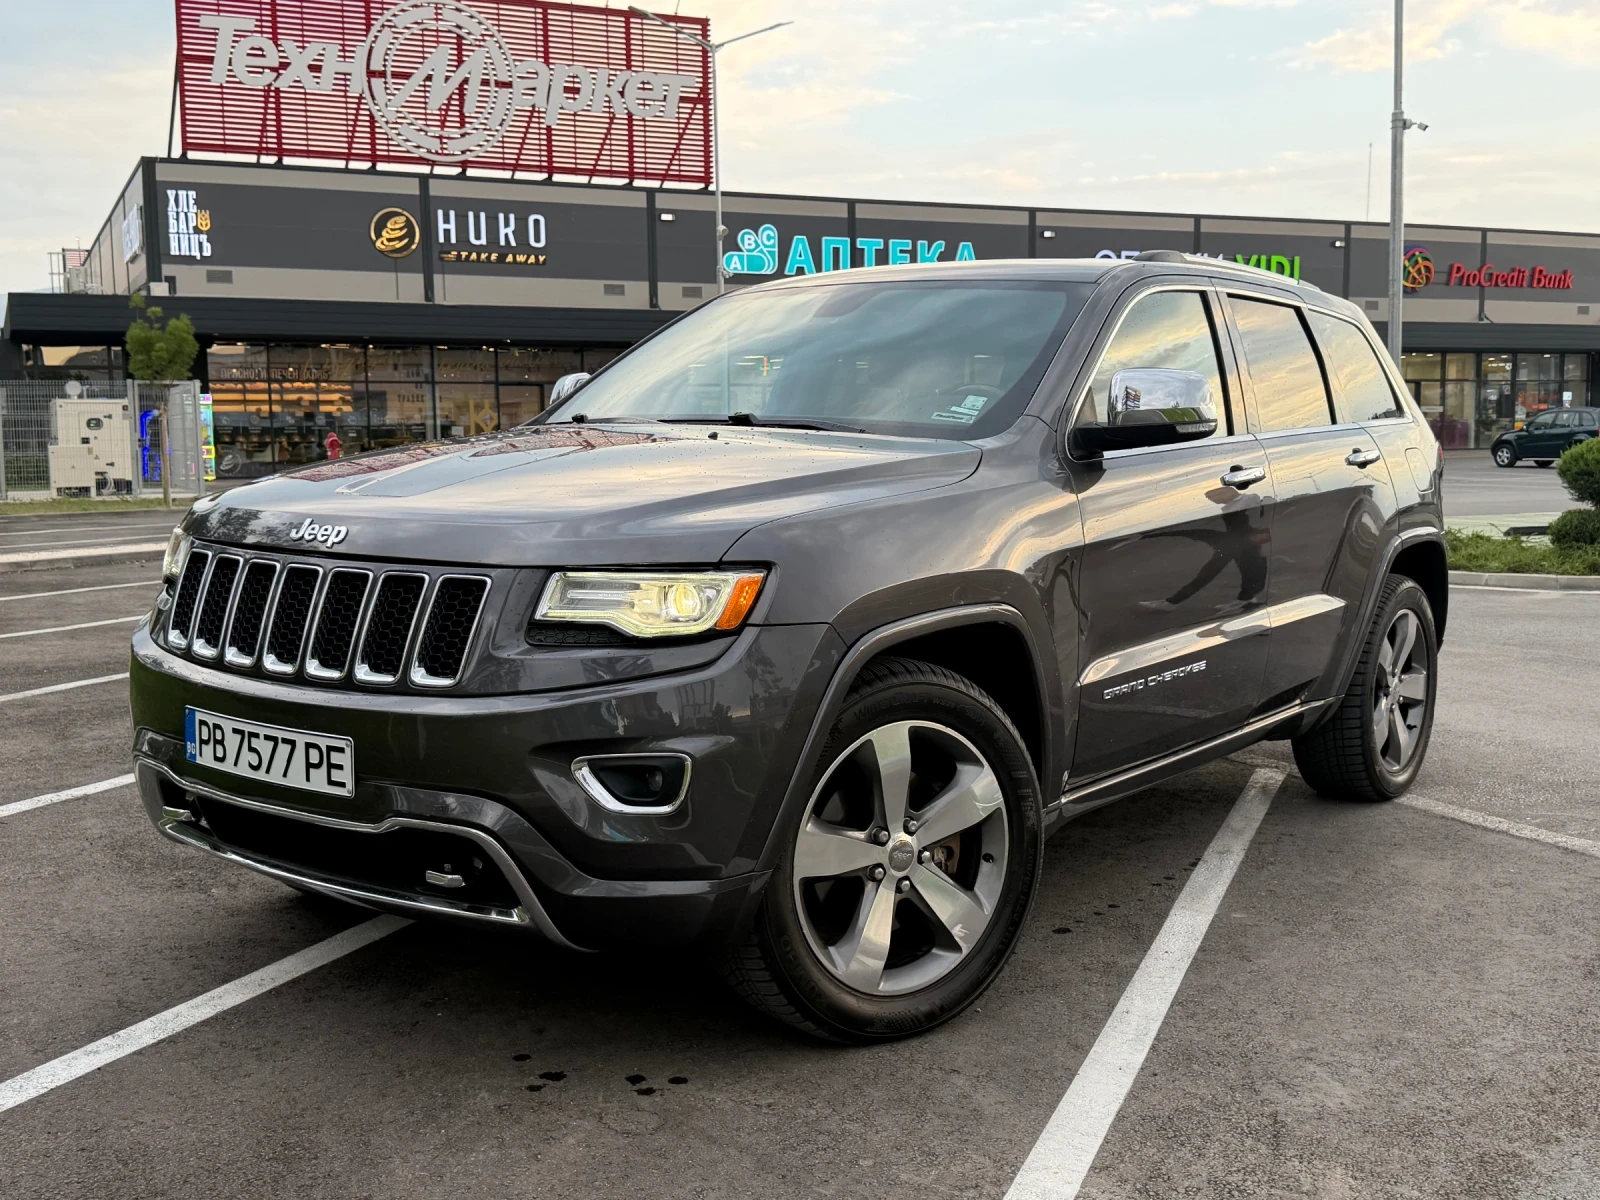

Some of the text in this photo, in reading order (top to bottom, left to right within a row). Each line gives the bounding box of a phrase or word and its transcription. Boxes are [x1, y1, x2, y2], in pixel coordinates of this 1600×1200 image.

[166, 189, 197, 213] ХЛЕ
[168, 211, 197, 234] БАР
[169, 233, 212, 260] НИЦЪ
[460, 251, 546, 265] TAKE AWAY
[784, 235, 977, 275] АПТЕКА
[1449, 262, 1574, 289] ProCredit Bank
[290, 518, 347, 547] Jeep
[1103, 660, 1207, 699] GRAND CHEROKEE
[187, 741, 196, 755] BG
